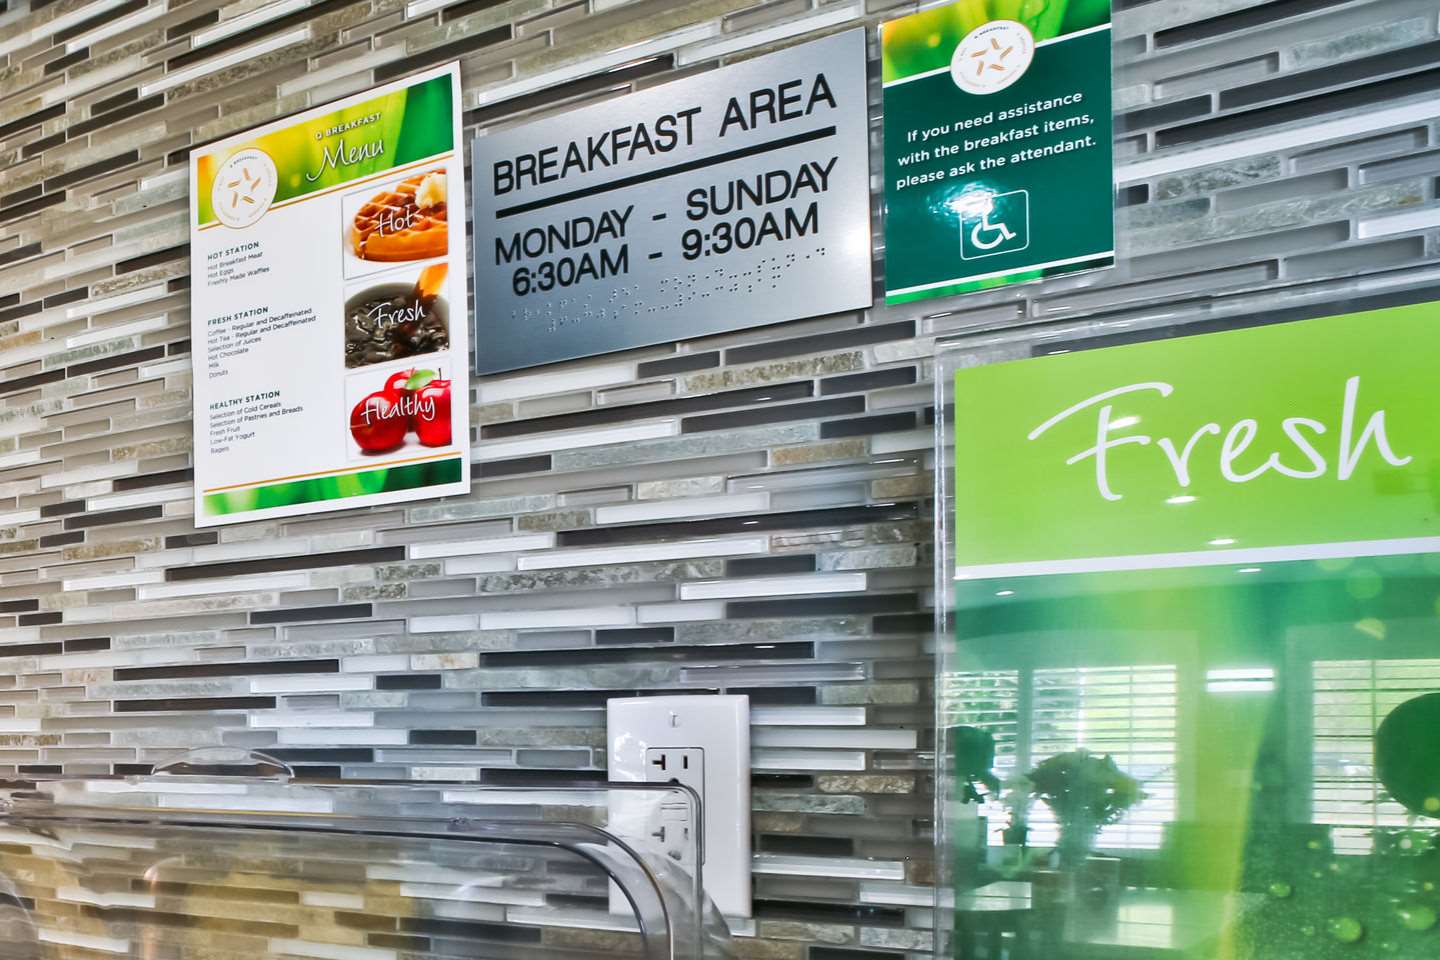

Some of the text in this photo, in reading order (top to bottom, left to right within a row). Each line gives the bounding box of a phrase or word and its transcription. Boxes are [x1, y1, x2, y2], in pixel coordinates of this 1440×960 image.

[325, 112, 381, 137] BREAKFAST
[907, 92, 1083, 143] If you need assistance
[493, 73, 837, 196] BREAKFAST AREA
[897, 114, 1094, 166] with the breakfast items,
[305, 138, 384, 181] Menu
[896, 135, 1096, 190] please ask the attendant.
[374, 205, 417, 237] Hot
[494, 156, 839, 266] MONDAY - SUNDAY
[208, 241, 260, 260] HOT STATION
[512, 202, 819, 297] 6:30AM - 9:30AM
[229, 272, 246, 281] Made
[247, 266, 270, 277] Waffles
[208, 306, 269, 326] FRESH STATION
[231, 321, 255, 332] Regular
[255, 317, 268, 326] and
[367, 300, 427, 329] Fresh
[208, 336, 262, 353] Selection of Juices
[219, 335, 230, 343] Tea
[235, 328, 258, 339] Regular
[259, 325, 272, 333] and
[210, 390, 281, 410] HEALTHY STATION
[210, 410, 236, 420] Selection
[258, 402, 282, 411] Cereals
[360, 394, 437, 425] Healthy
[210, 418, 236, 428] Selection
[244, 413, 268, 422] Pastries
[281, 405, 304, 415] Breads
[235, 431, 256, 441] Yogurt
[1027, 376, 1413, 502] Fresh
